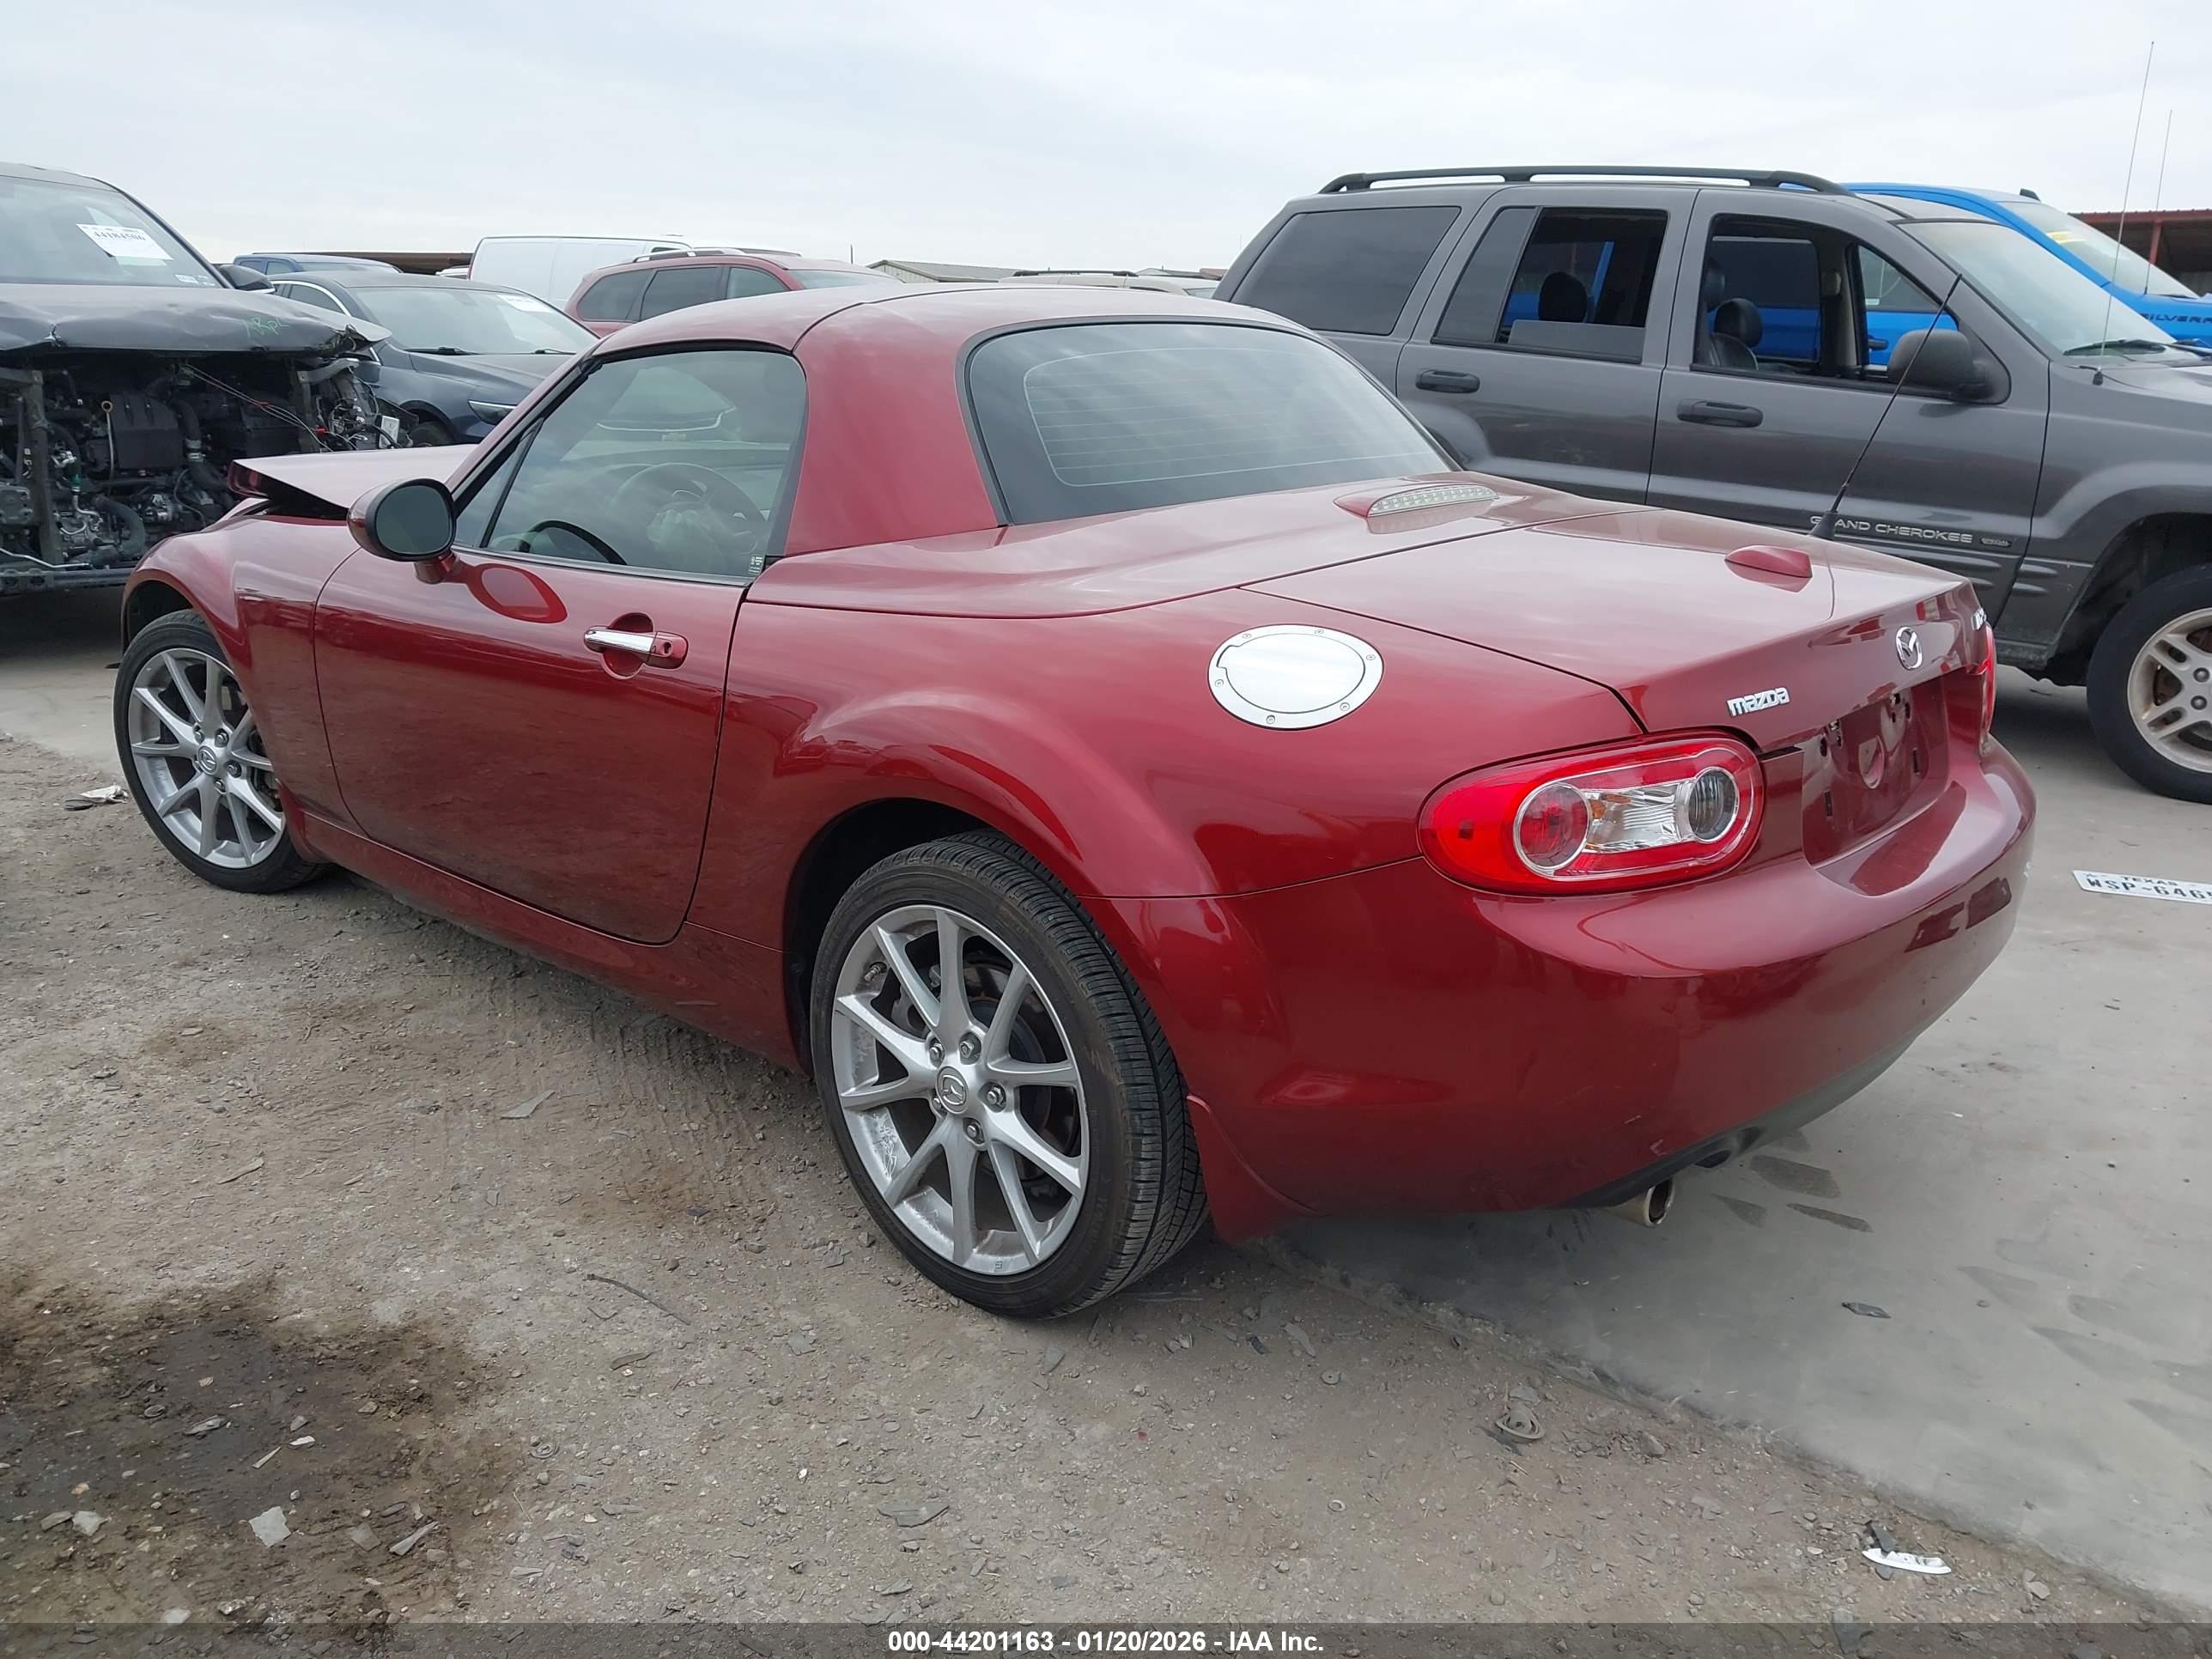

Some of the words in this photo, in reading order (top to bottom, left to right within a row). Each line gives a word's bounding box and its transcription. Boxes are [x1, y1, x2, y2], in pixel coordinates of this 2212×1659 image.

[1809, 515, 1870, 531] GAND
[1875, 523, 1974, 544] CHEROKEE
[2122, 876, 2179, 886] TEXAS
